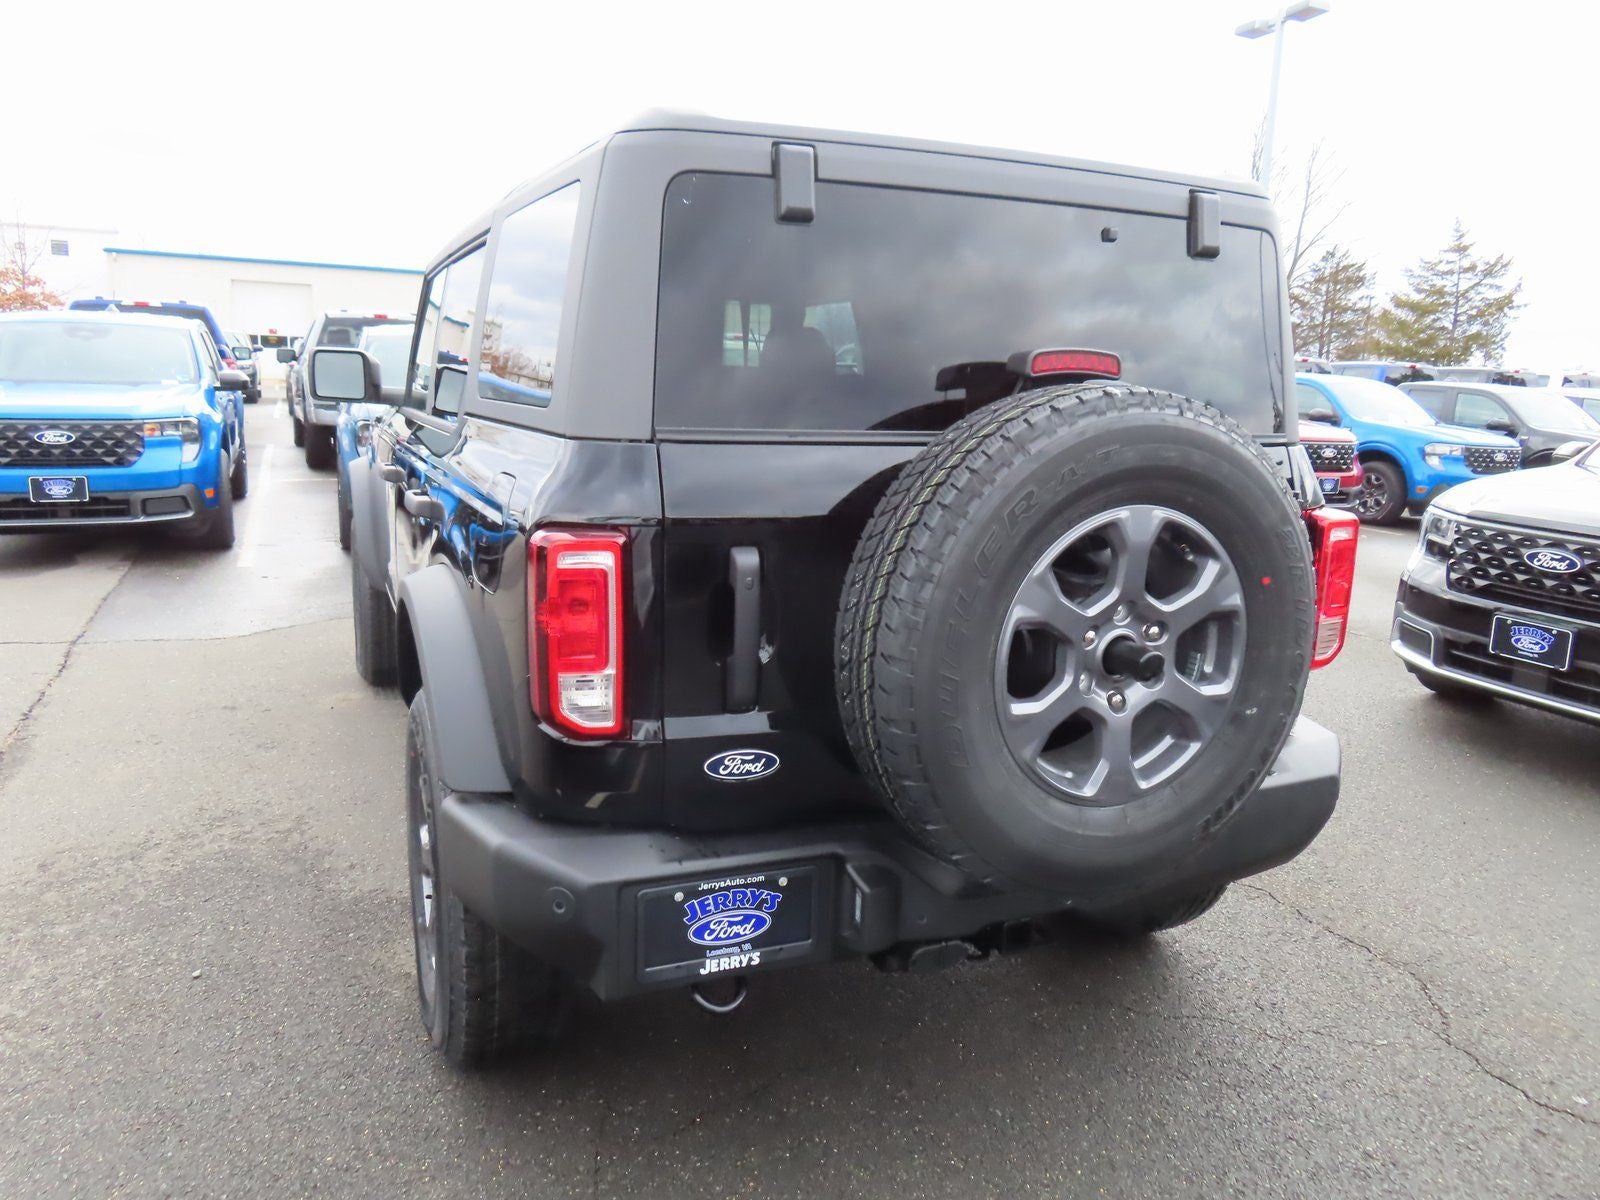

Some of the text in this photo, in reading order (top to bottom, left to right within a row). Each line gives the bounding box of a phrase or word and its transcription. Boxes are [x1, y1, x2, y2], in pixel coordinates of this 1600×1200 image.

[1533, 552, 1570, 570] Ford
[1517, 638, 1542, 650] Ford
[719, 754, 766, 775] Ford
[698, 875, 765, 891] JerrysAuto.com
[683, 887, 783, 925] JERRY'S
[703, 915, 756, 941] Ford
[699, 951, 761, 975] JERRY'S
